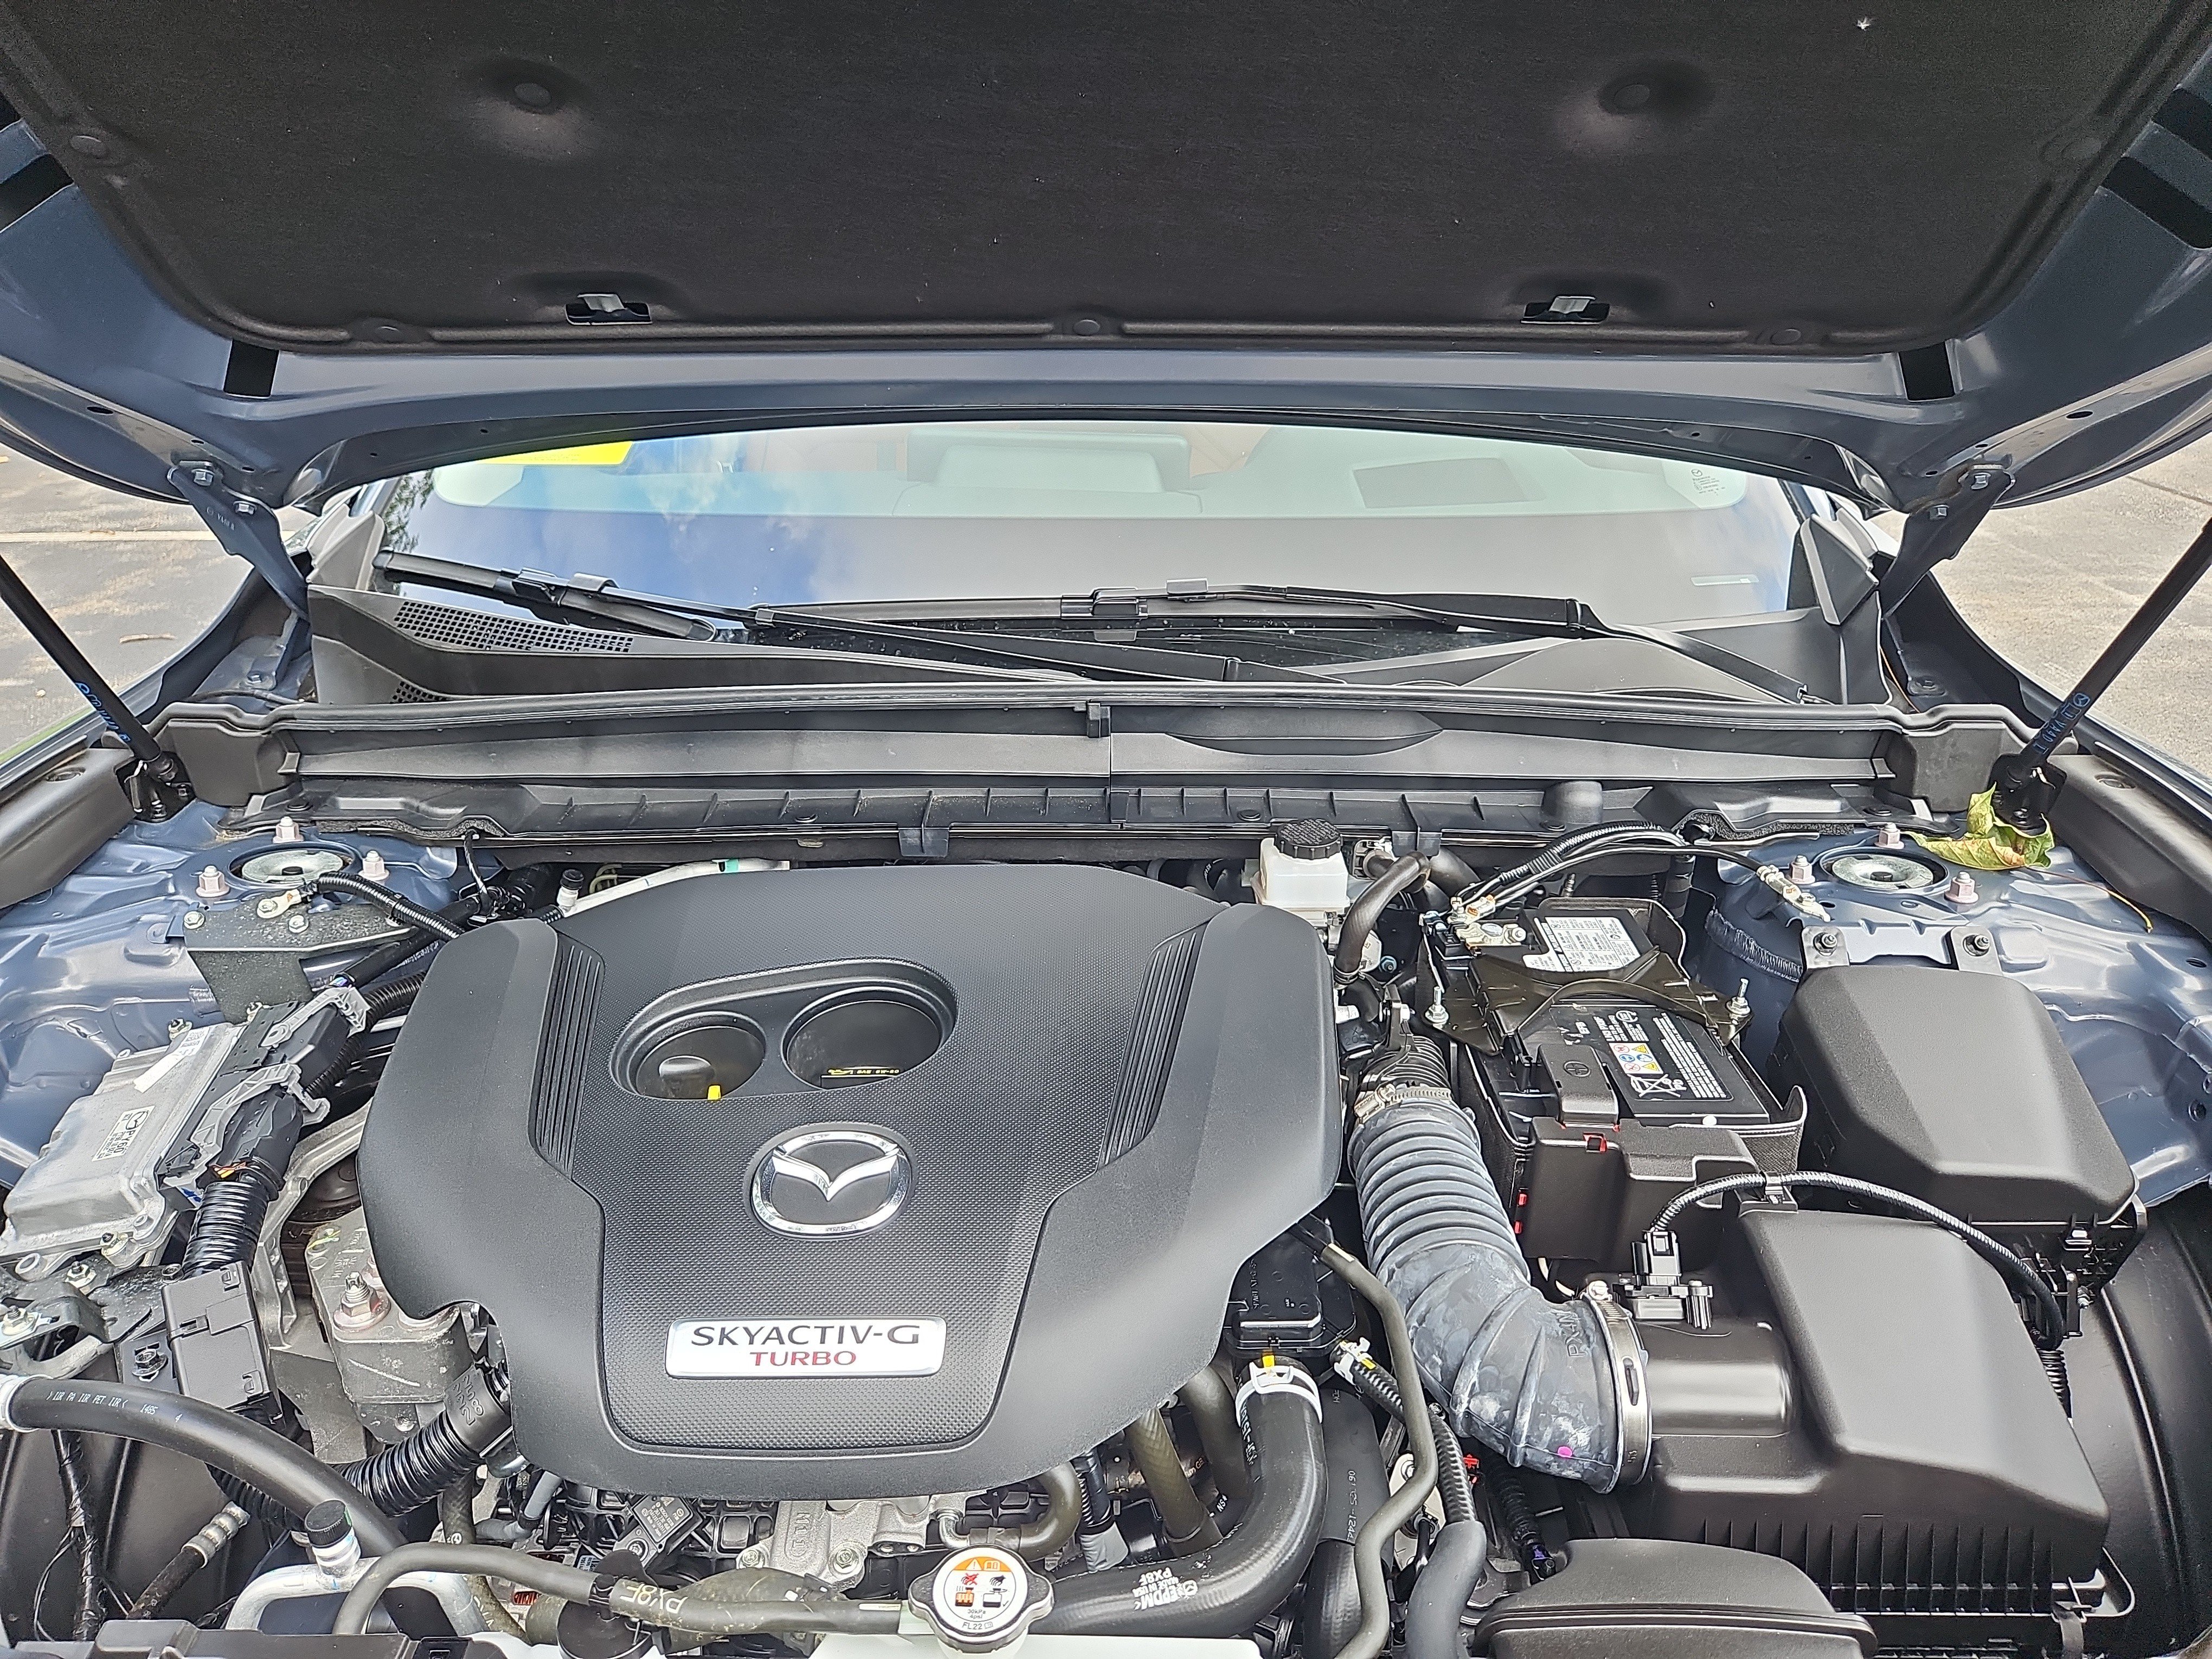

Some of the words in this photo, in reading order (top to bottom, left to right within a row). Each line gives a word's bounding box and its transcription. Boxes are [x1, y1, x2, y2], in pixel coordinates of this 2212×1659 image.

[113, 1130, 136, 1153] PY60
[691, 1324, 921, 1346] SKYACTIV-G
[750, 1351, 857, 1367] TURBO
[1139, 1567, 1173, 1586] PX8F
[961, 1622, 983, 1630] FL22
